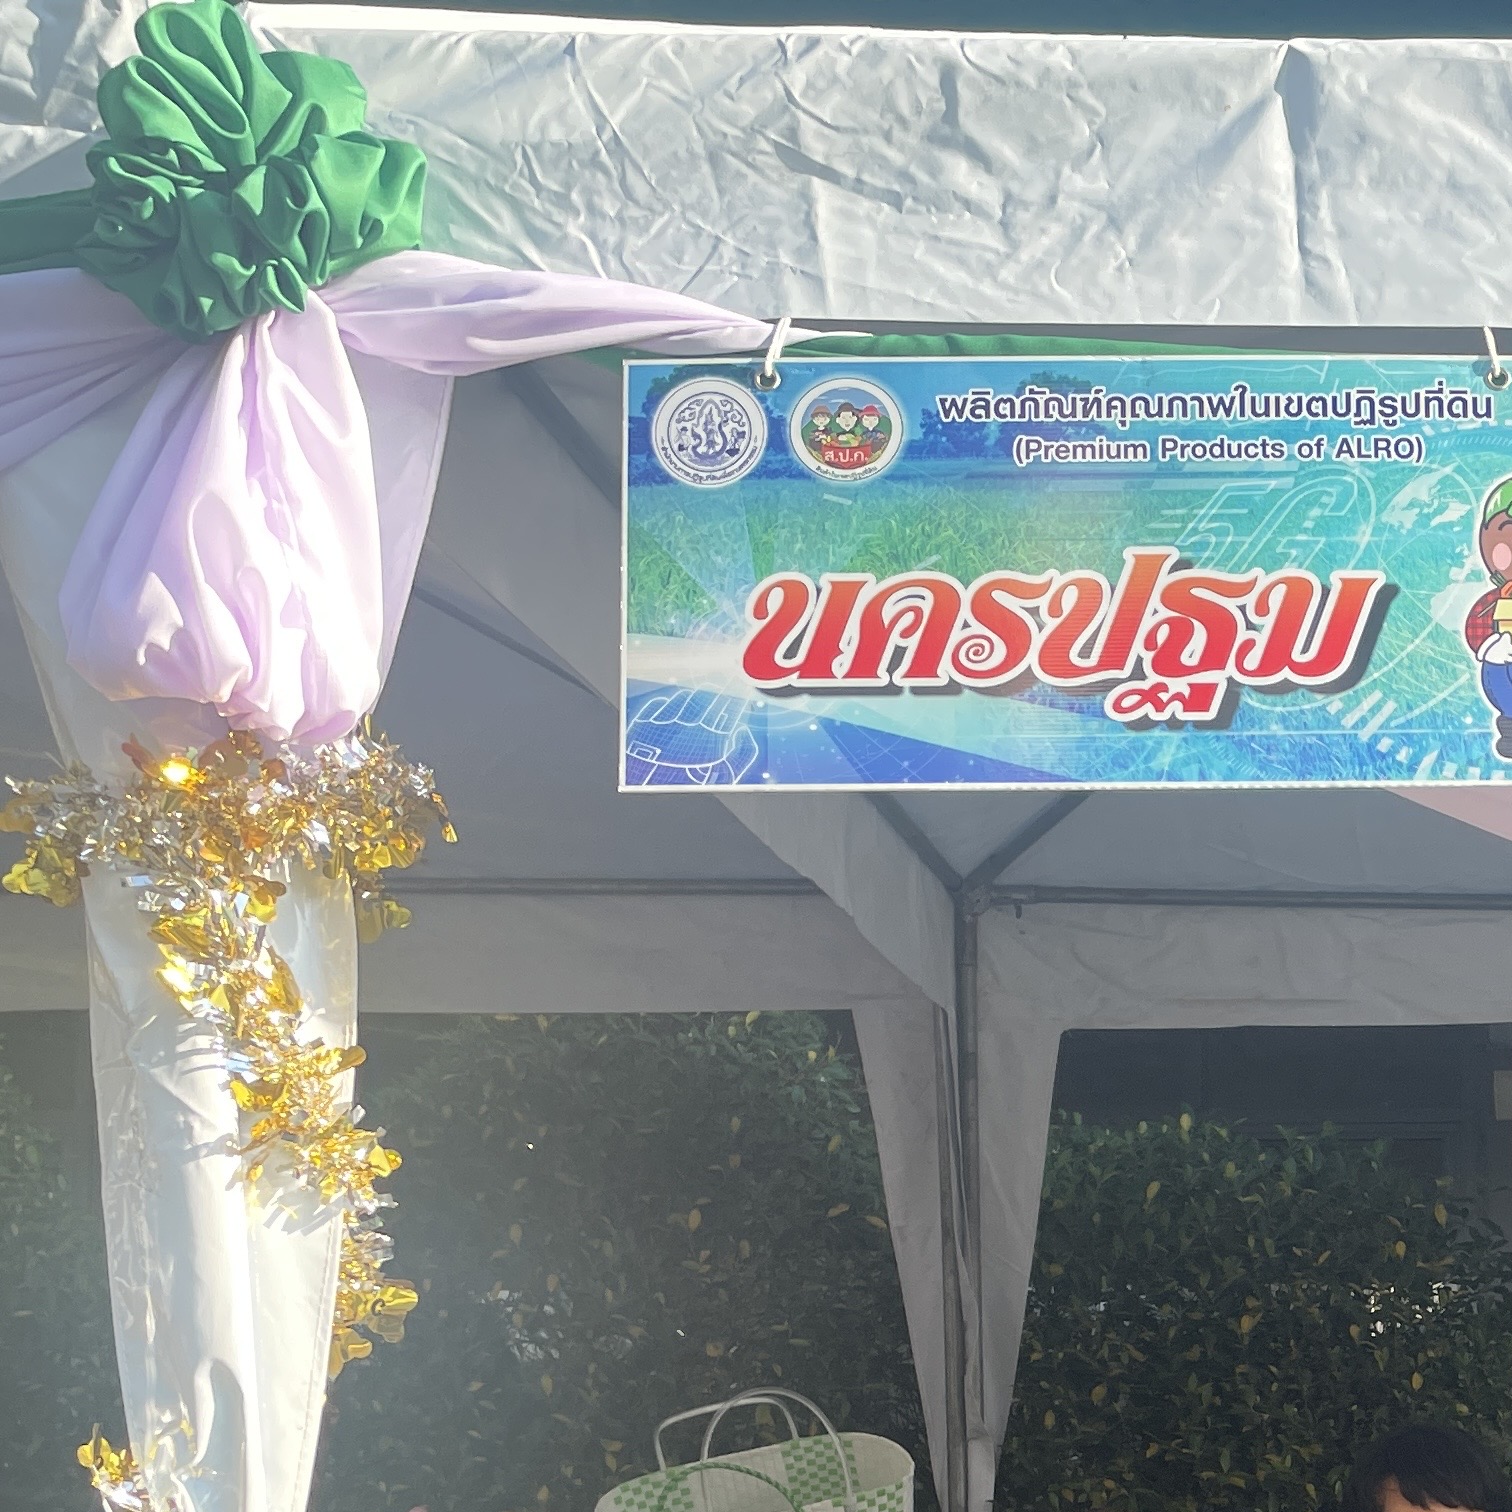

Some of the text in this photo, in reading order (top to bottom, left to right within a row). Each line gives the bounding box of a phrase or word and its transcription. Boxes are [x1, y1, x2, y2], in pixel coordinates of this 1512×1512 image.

[938, 381, 1493, 428] ผลิตภัณฑ์คุณภาพในเขตปฏิรูปที่ดิน
[824, 449, 869, 463] ส.ป.ก.
[1016, 437, 1424, 465] (Premium Products of ALRO)
[742, 551, 1384, 719] นครปฐม
